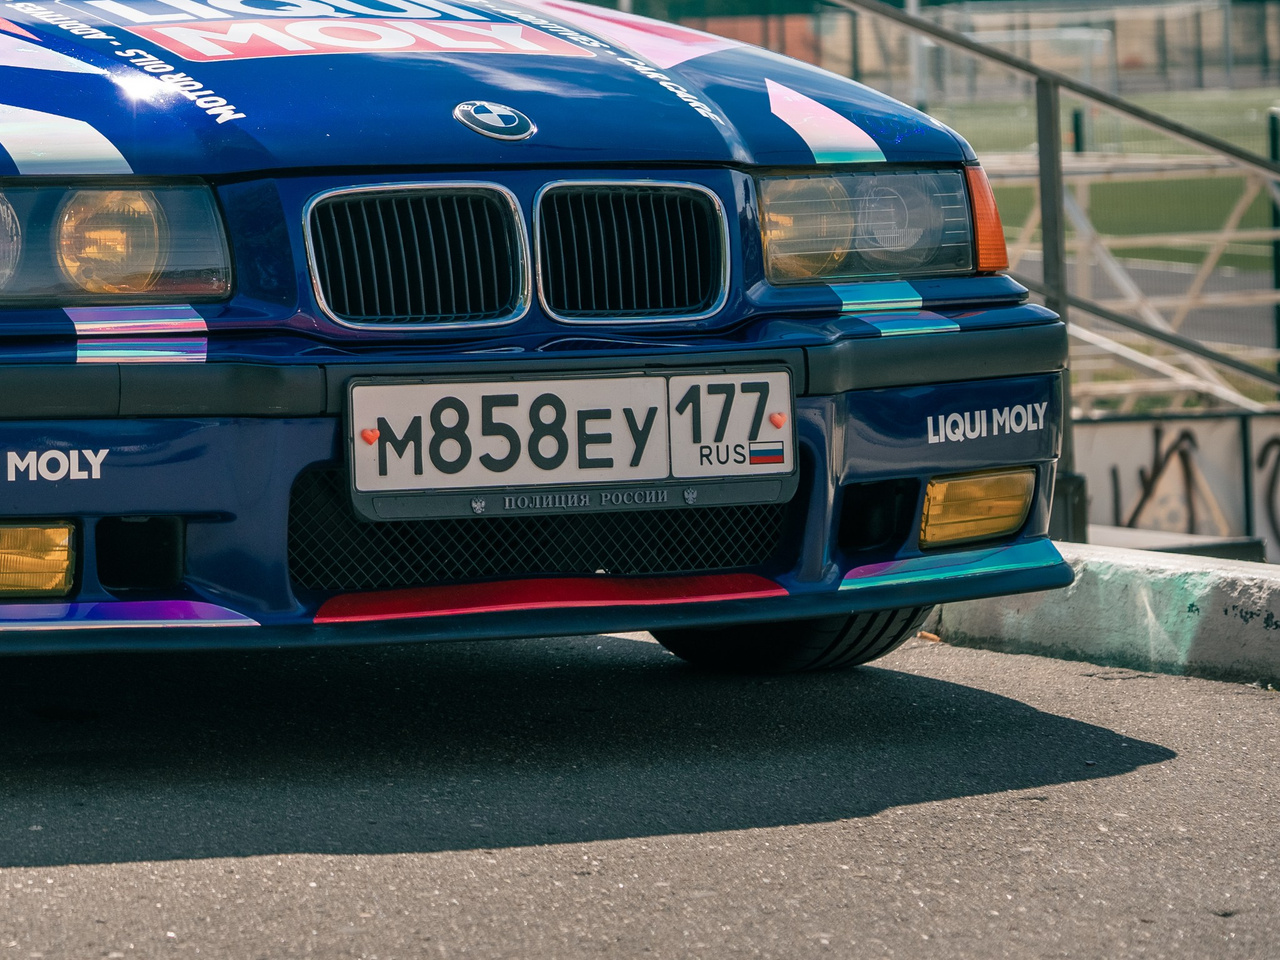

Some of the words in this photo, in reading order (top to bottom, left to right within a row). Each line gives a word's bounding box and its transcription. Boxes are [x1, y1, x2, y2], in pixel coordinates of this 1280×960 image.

[6, 2, 114, 40] ADDITIVES
[152, 19, 549, 57] MOLY
[115, 48, 175, 73] OILS
[160, 72, 246, 124] MOTOR
[675, 381, 770, 444] 177
[926, 409, 988, 444] LIQUI
[991, 401, 1049, 436] MOLY
[7, 448, 110, 482] MOLY
[699, 444, 746, 466] RUS
[503, 492, 591, 511] ПОЛИЦИЯ
[599, 489, 669, 507] РОССИИ
